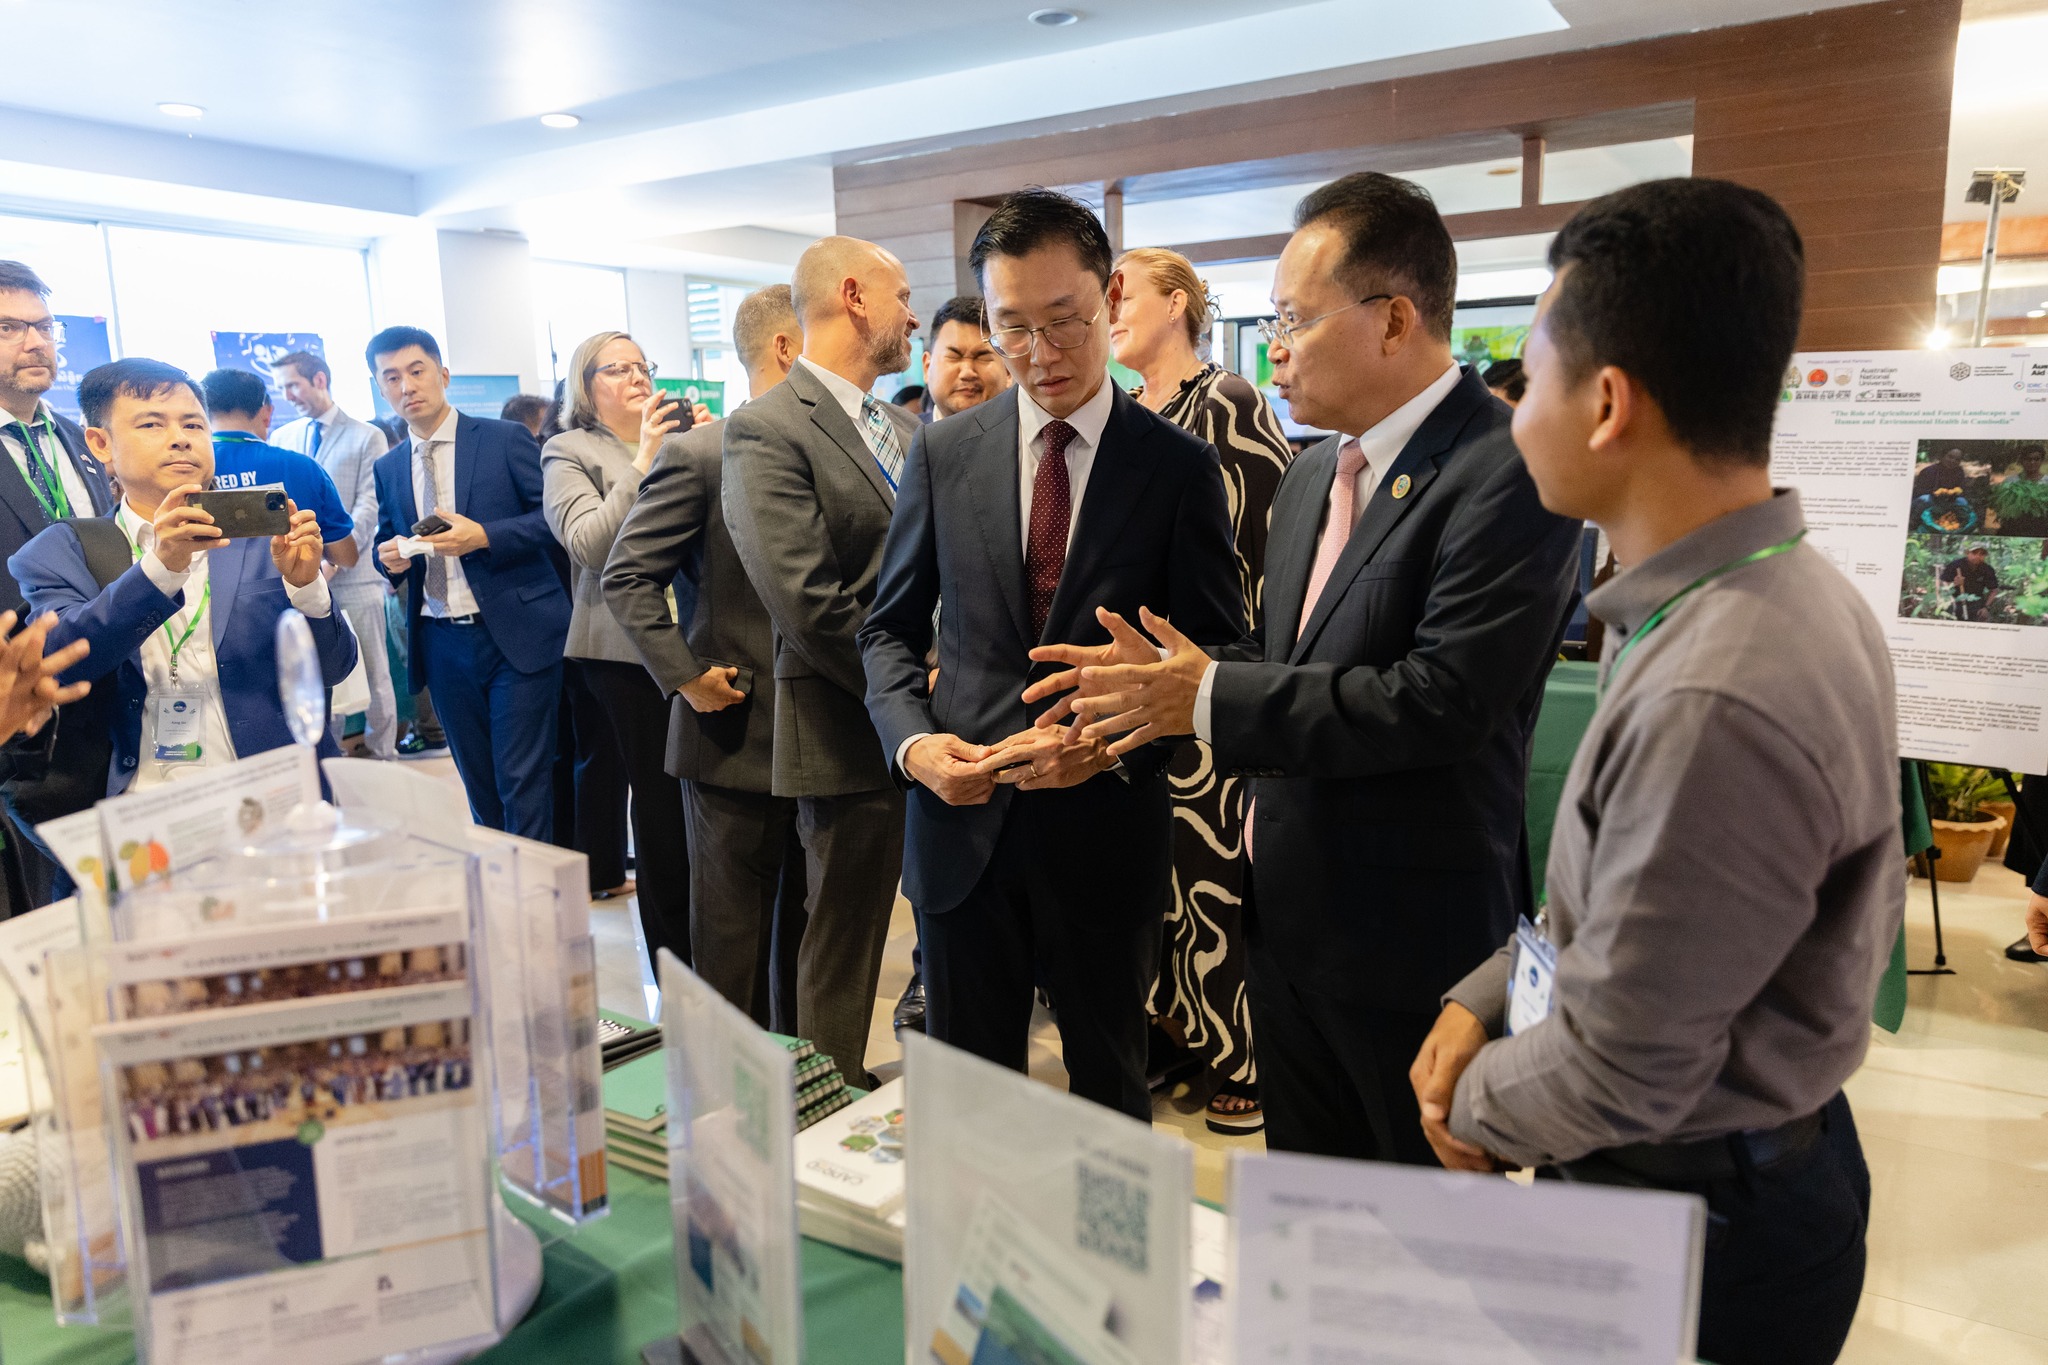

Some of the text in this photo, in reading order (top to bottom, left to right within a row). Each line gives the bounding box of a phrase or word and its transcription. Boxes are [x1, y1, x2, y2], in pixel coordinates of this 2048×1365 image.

[1877, 409, 1921, 418] Agricultural
[1922, 409, 1935, 417] and
[1937, 409, 1961, 417] Forest
[1962, 409, 2006, 419] Landscapes
[240, 470, 257, 487] BY
